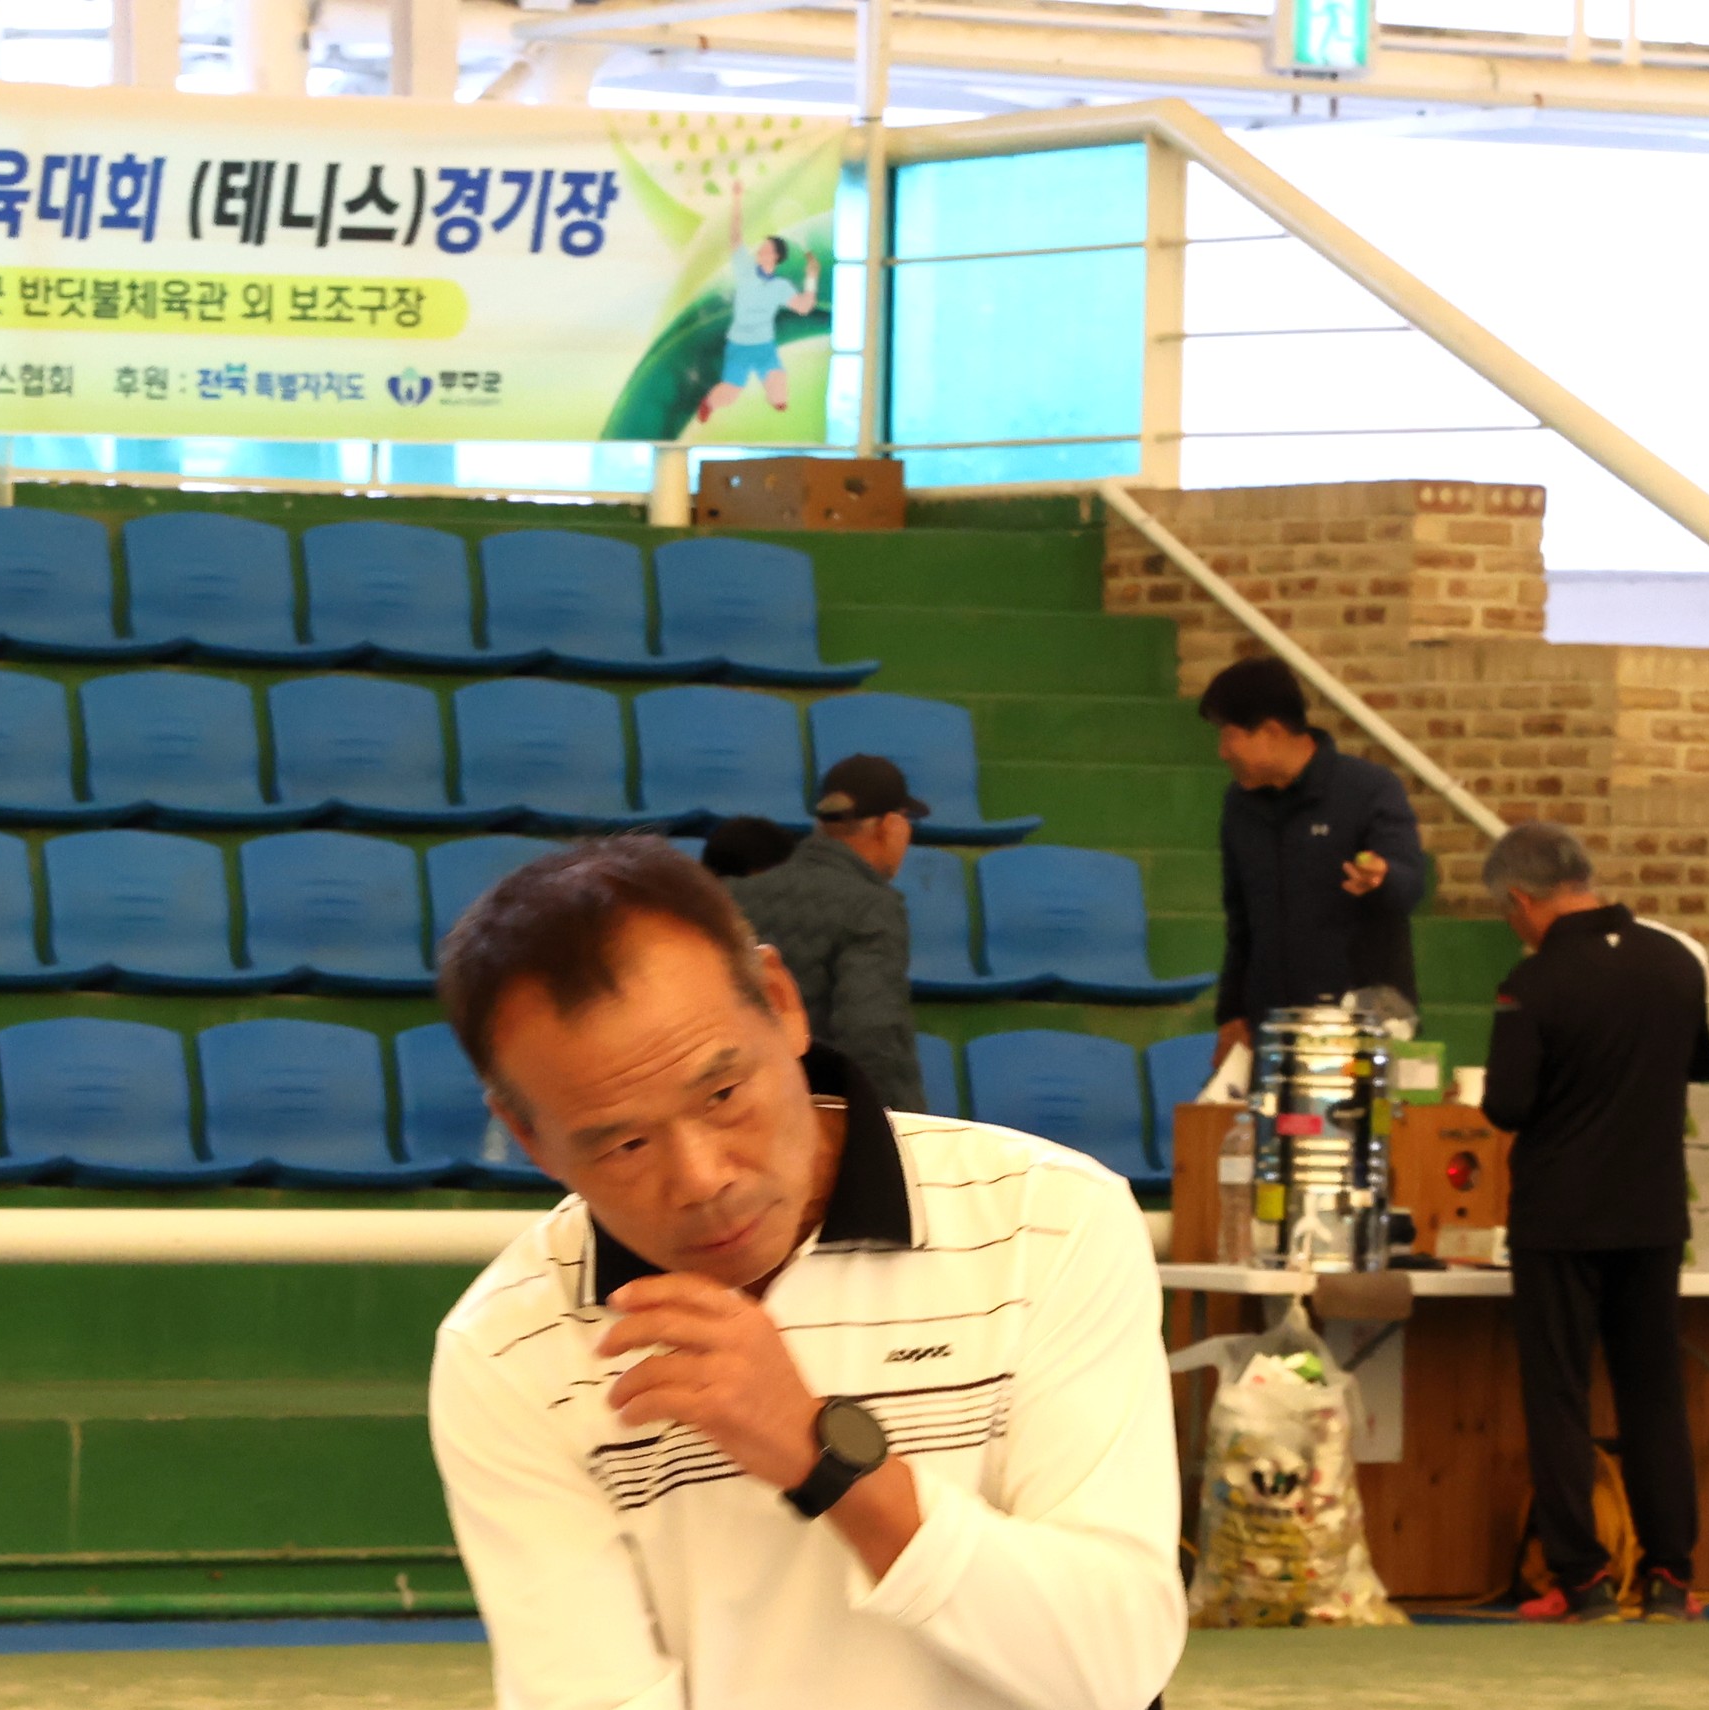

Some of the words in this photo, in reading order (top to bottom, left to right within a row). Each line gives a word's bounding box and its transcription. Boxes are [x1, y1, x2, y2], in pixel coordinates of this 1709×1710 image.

[189, 159, 620, 257] (테니스)경기장
[19, 276, 229, 321] 반딧불체육관
[240, 281, 274, 323] 외
[288, 283, 427, 328] 보조구장
[113, 365, 169, 400] 후원
